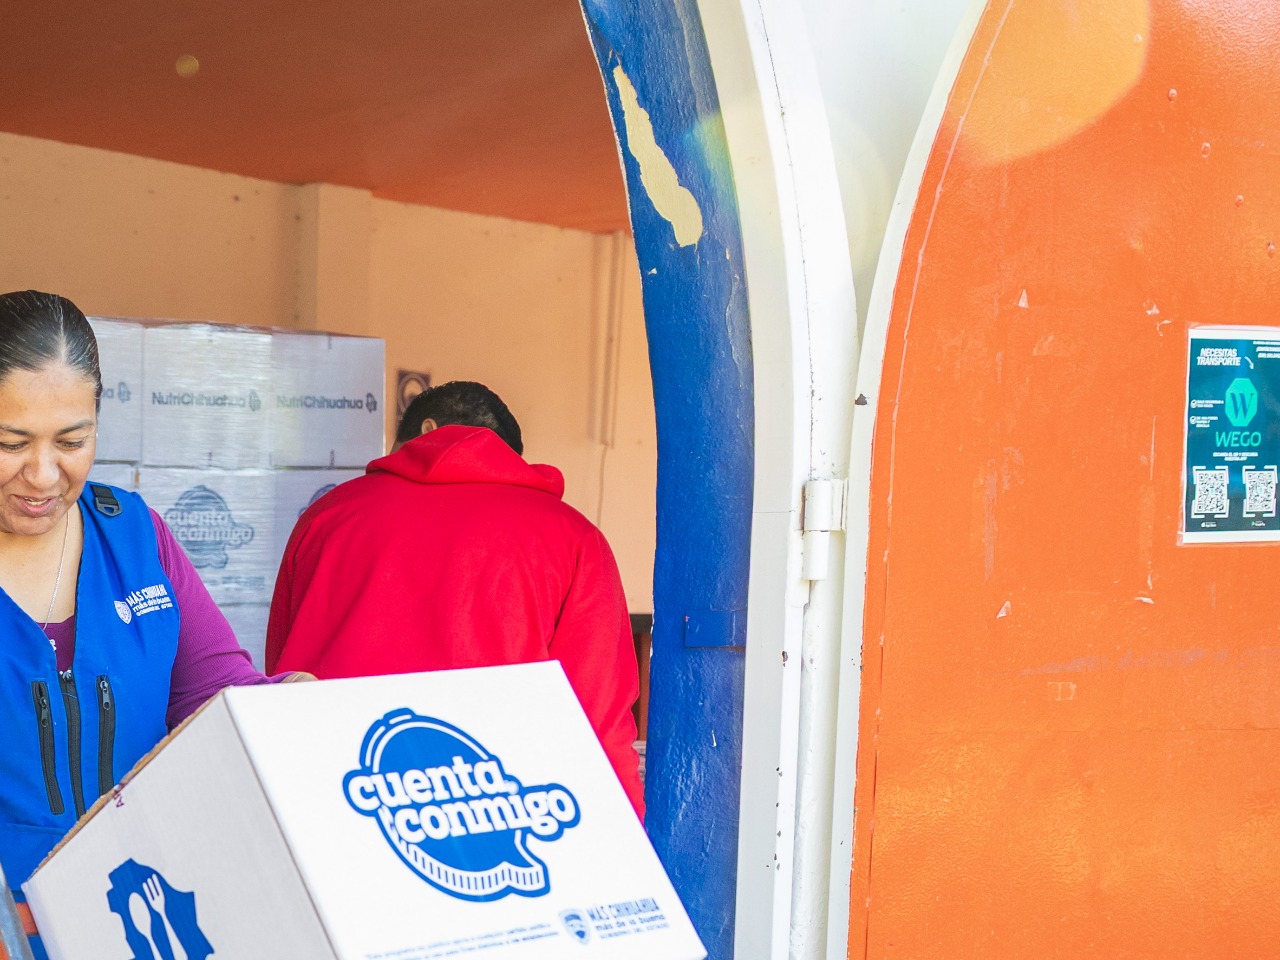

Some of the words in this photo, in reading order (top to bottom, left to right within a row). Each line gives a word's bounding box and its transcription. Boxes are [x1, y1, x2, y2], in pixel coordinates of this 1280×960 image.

[1196, 356, 1241, 366] TRANSPORTE
[1200, 347, 1237, 357] NECESITAS
[1230, 393, 1254, 419] W
[1215, 431, 1261, 447] WEGO
[348, 755, 510, 811] cuenta
[394, 782, 576, 843] conmigo
